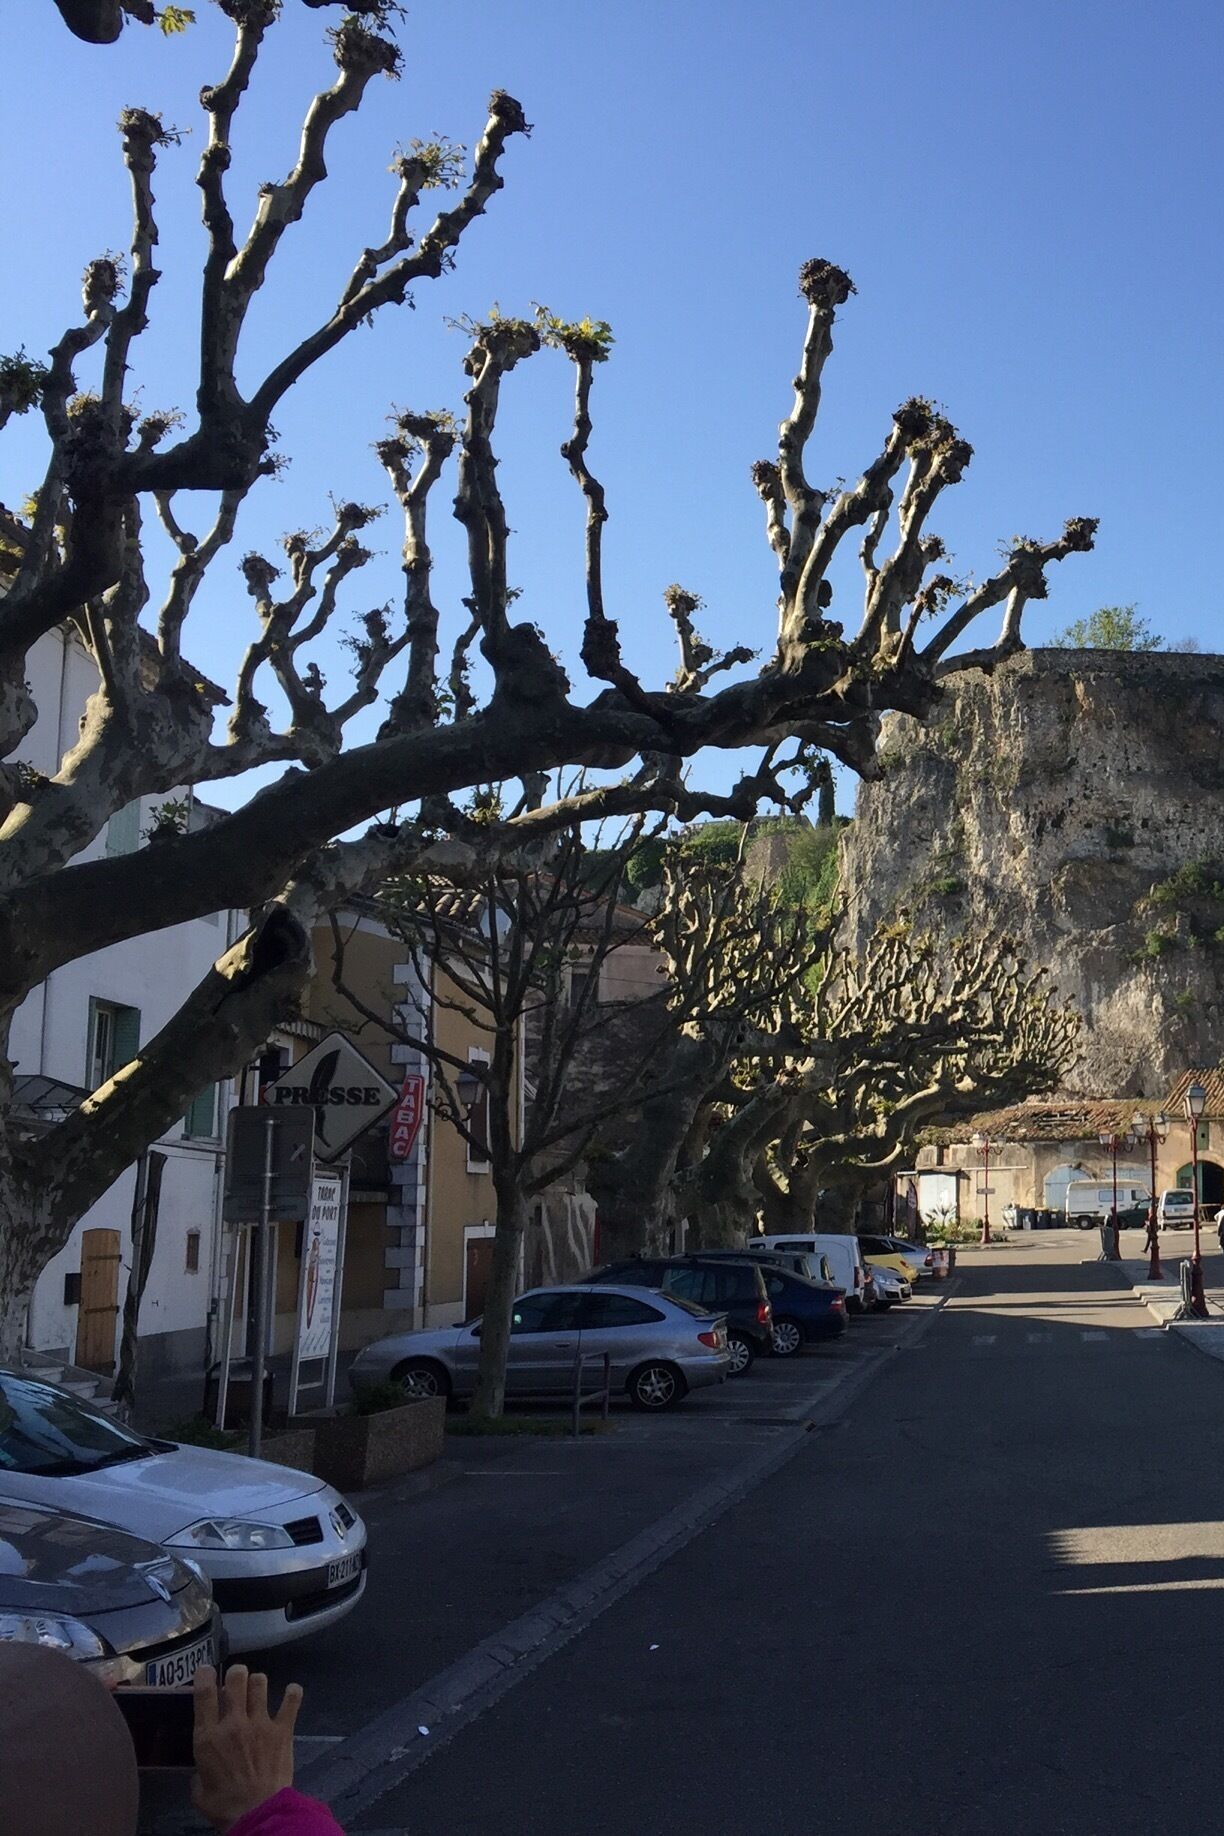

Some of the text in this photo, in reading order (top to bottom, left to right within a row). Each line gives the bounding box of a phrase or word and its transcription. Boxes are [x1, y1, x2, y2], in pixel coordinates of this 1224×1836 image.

[274, 1086, 381, 1106] PRESSE
[392, 1078, 420, 1156] TABAC
[322, 1205, 338, 1220] PORT
